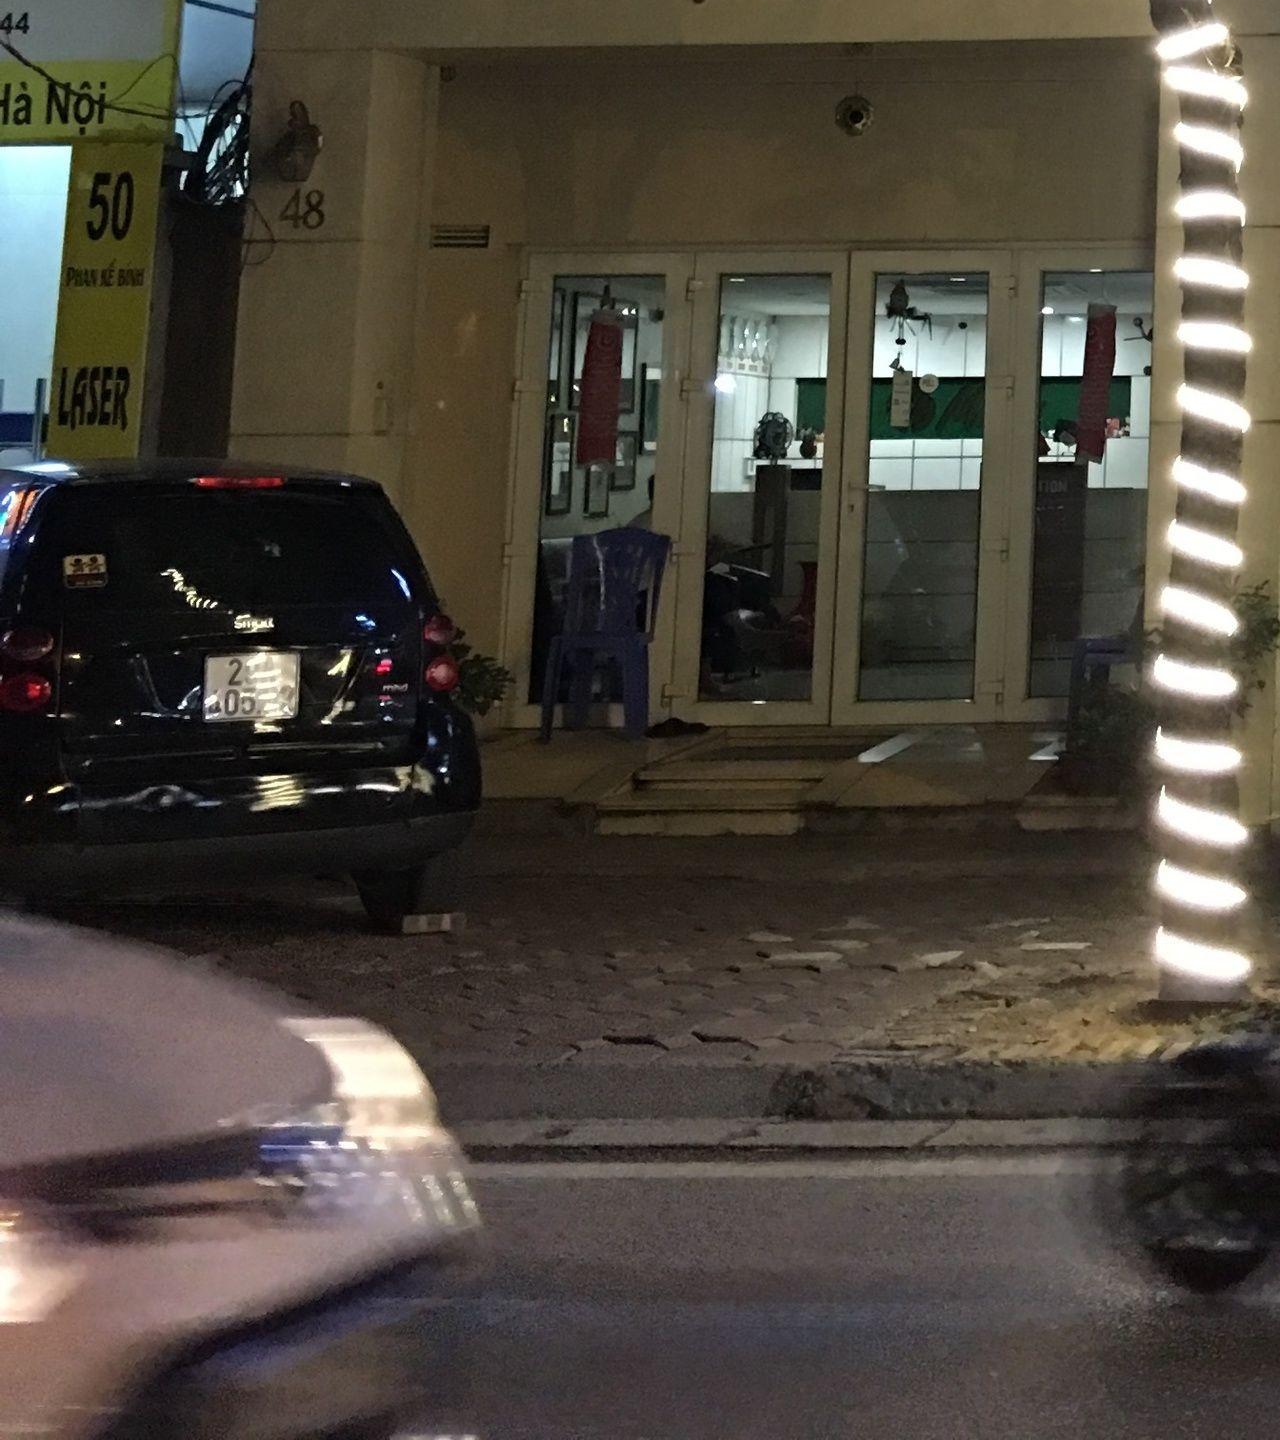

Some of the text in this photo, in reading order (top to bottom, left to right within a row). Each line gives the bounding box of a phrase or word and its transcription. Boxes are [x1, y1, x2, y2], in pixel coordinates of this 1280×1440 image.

[46, 81, 107, 136] Nội
[86, 171, 134, 241] 50
[279, 188, 325, 230] 48
[57, 366, 130, 431] LASER
